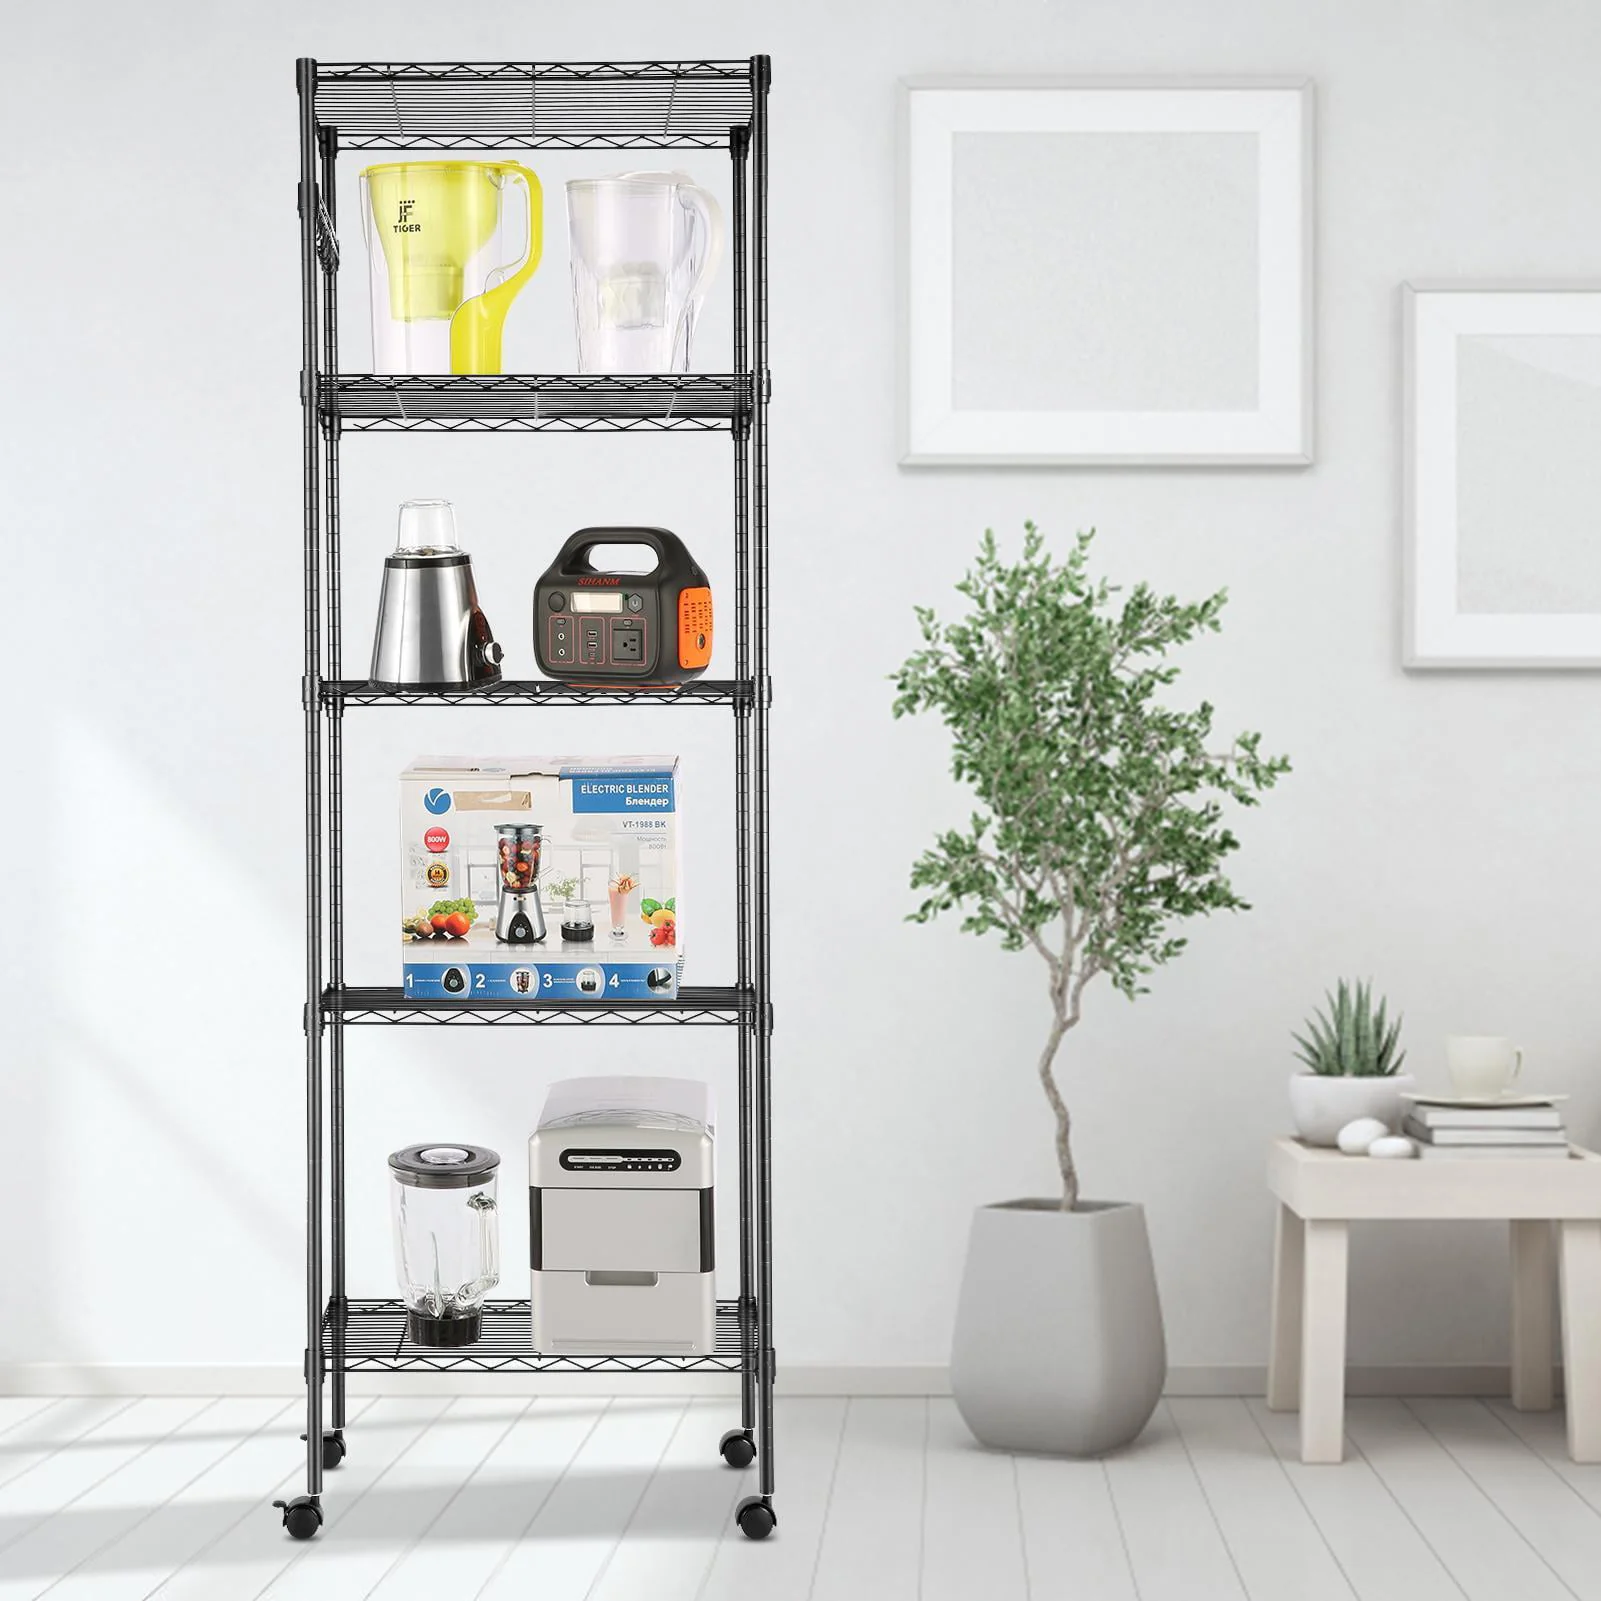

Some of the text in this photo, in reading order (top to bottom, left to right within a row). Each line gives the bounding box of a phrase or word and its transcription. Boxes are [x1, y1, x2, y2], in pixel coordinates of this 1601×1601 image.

[393, 224, 421, 233] TIGER
[581, 784, 669, 794] ELECTRIC BLENDER
[625, 797, 669, 807] Блендер
[654, 820, 666, 828] BK
[406, 973, 414, 988] 1
[475, 973, 486, 988] 2
[543, 973, 553, 988] 3
[608, 973, 620, 988] 4
